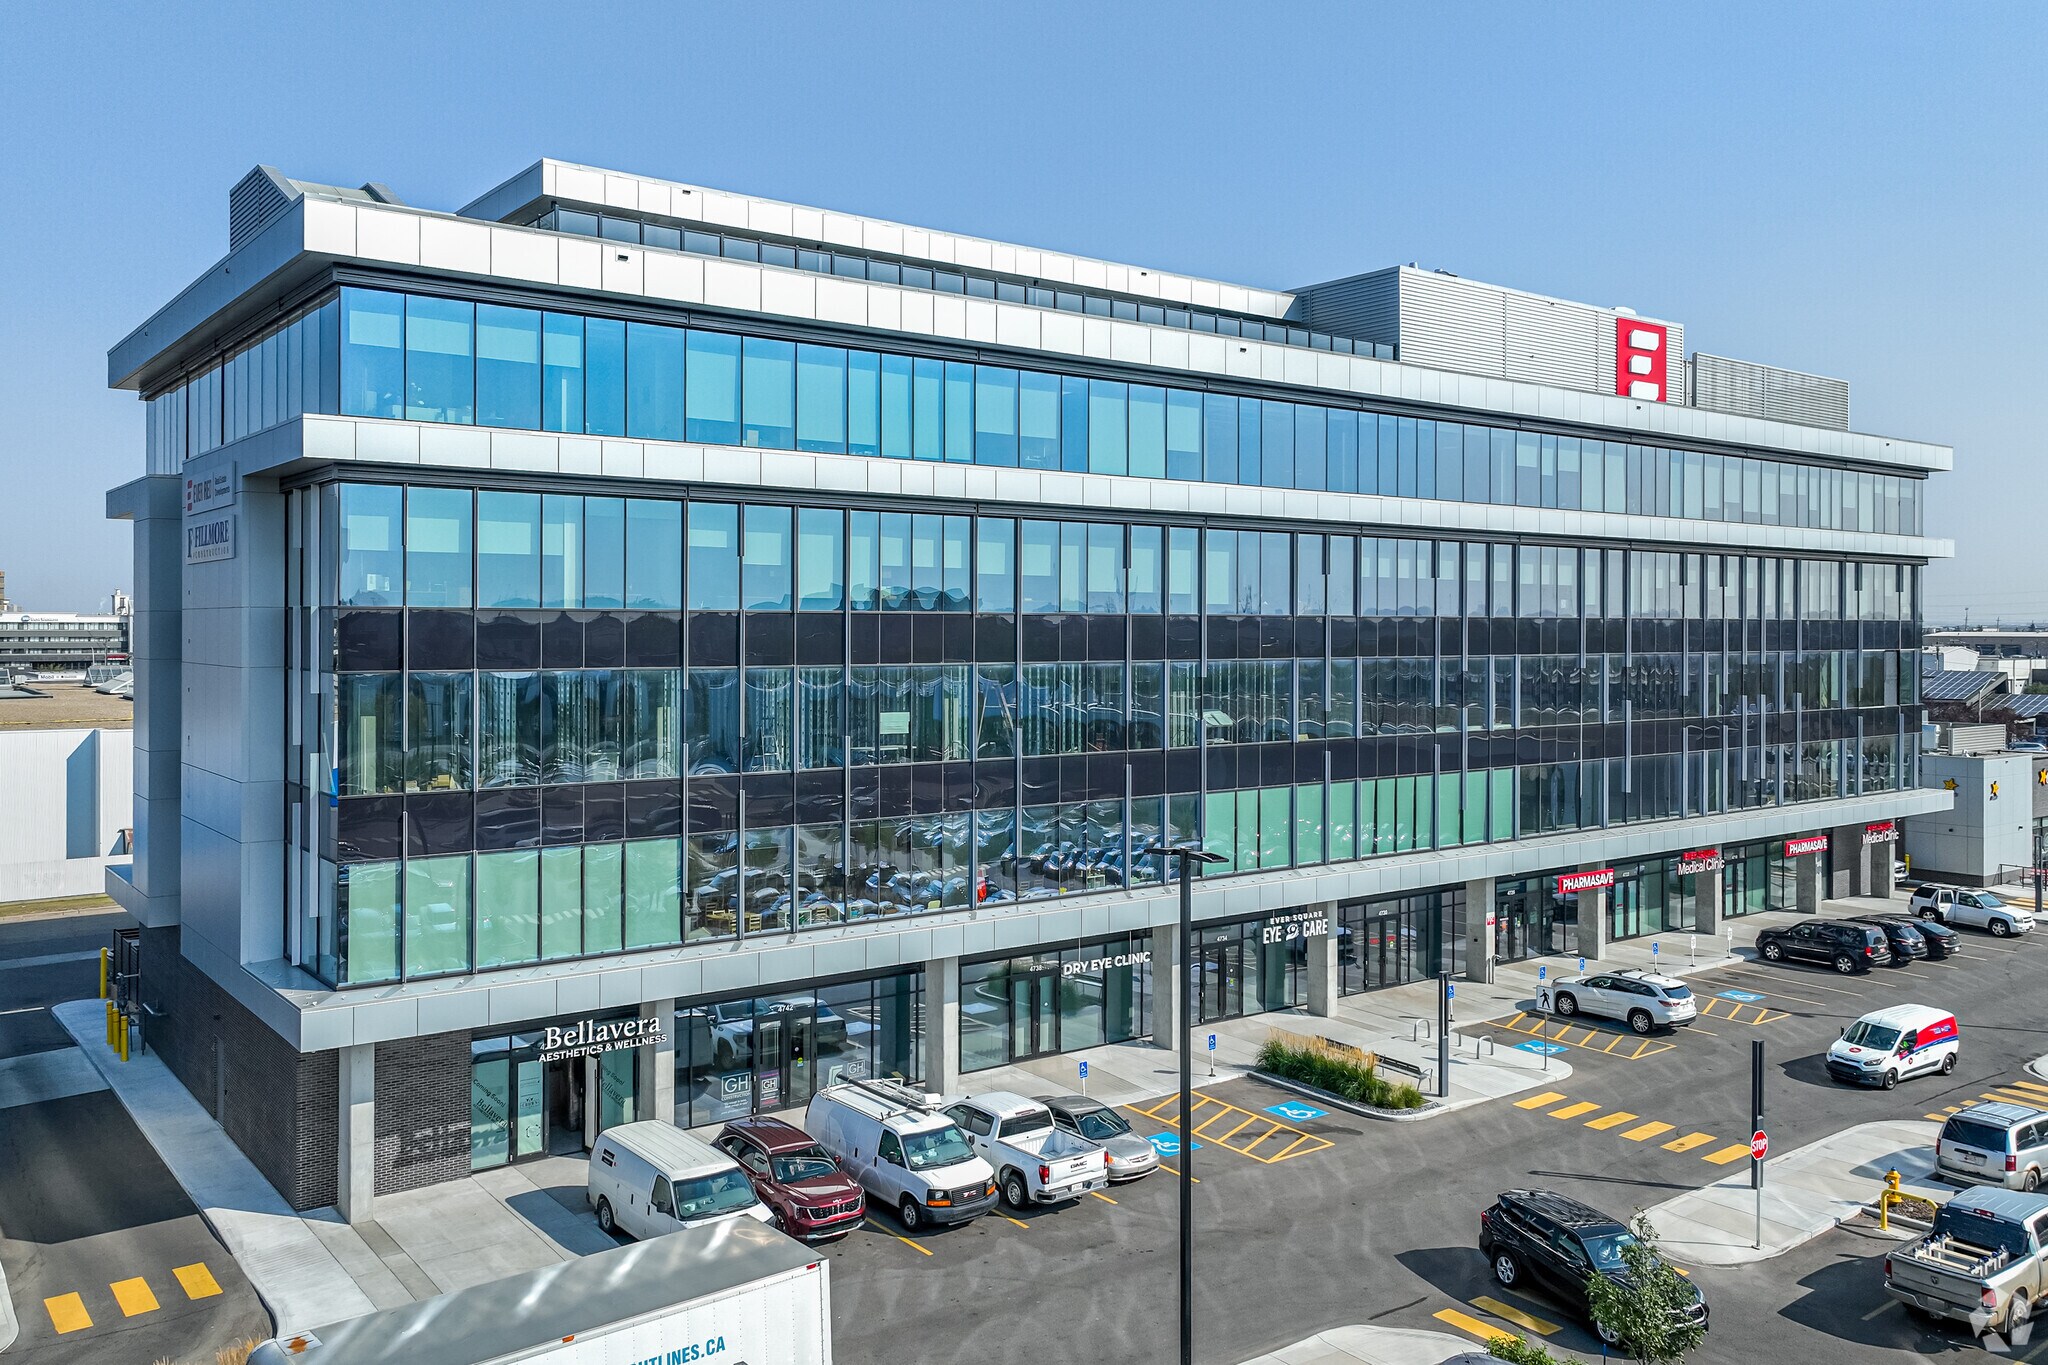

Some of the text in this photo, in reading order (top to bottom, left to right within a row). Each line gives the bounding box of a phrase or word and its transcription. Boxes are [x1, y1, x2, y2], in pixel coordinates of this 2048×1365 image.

[194, 520, 229, 548] FILLMORE
[1789, 838, 1828, 855] PHARMASAVE
[1862, 829, 1900, 845] Medical Clinic
[1677, 856, 1726, 876] Medical Clinic
[1562, 871, 1614, 892] PHARMASAVE
[1270, 910, 1323, 925] EVER SQUARE
[1262, 918, 1329, 944] EYE CARE
[1062, 951, 1152, 976] DRY EYE CLINIC
[777, 1004, 794, 1012] 4742
[544, 1016, 662, 1051] Bellavera
[538, 1043, 604, 1063] AESTHETICS
[604, 1042, 614, 1053] &
[614, 1033, 668, 1051] WELLNESS
[473, 1078, 492, 1098] Coming
[725, 1075, 749, 1093] GH
[763, 1079, 777, 1089] GH
[1751, 1138, 1768, 1152] STOP
[1070, 1160, 1087, 1169] GMC
